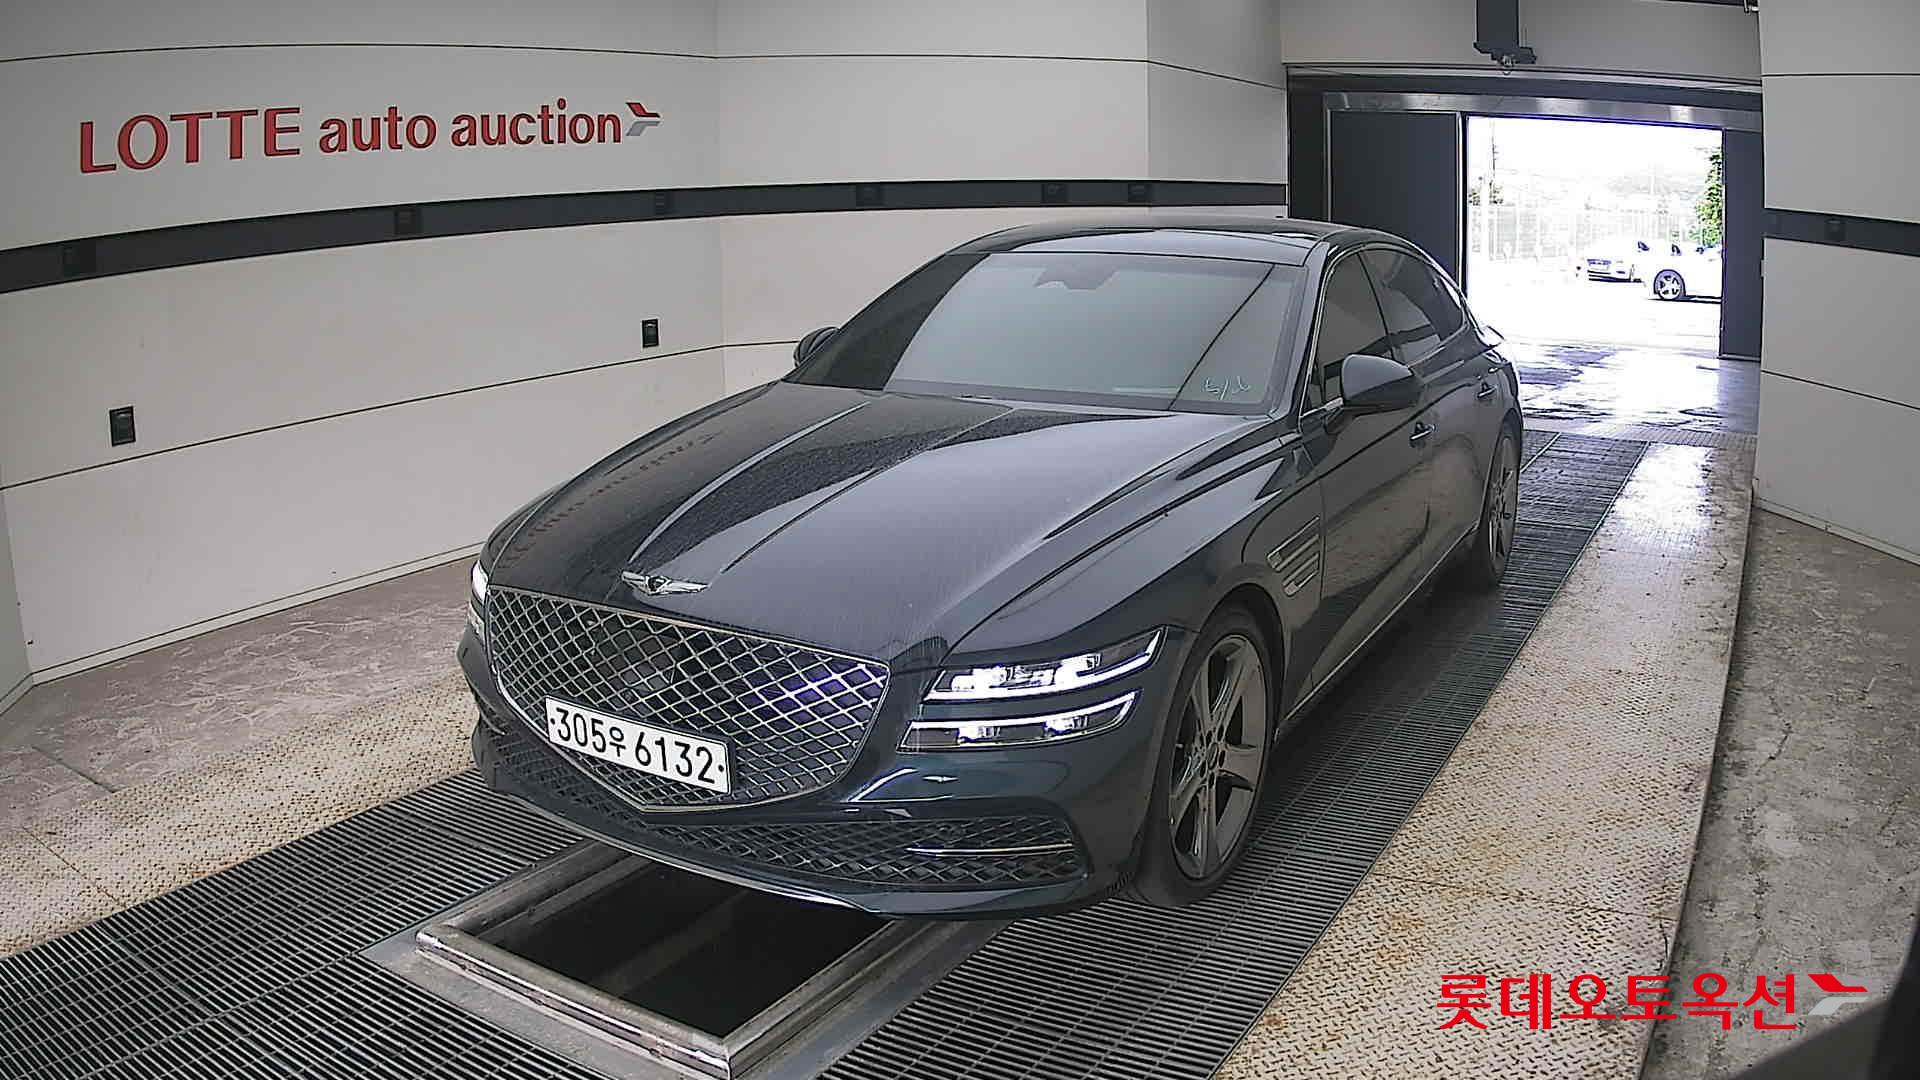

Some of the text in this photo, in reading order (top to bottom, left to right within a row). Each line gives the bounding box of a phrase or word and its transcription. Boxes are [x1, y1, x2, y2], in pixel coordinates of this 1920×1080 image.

[79, 98, 623, 174] LOTTE auto auction
[556, 707, 715, 784] 305우 6132
